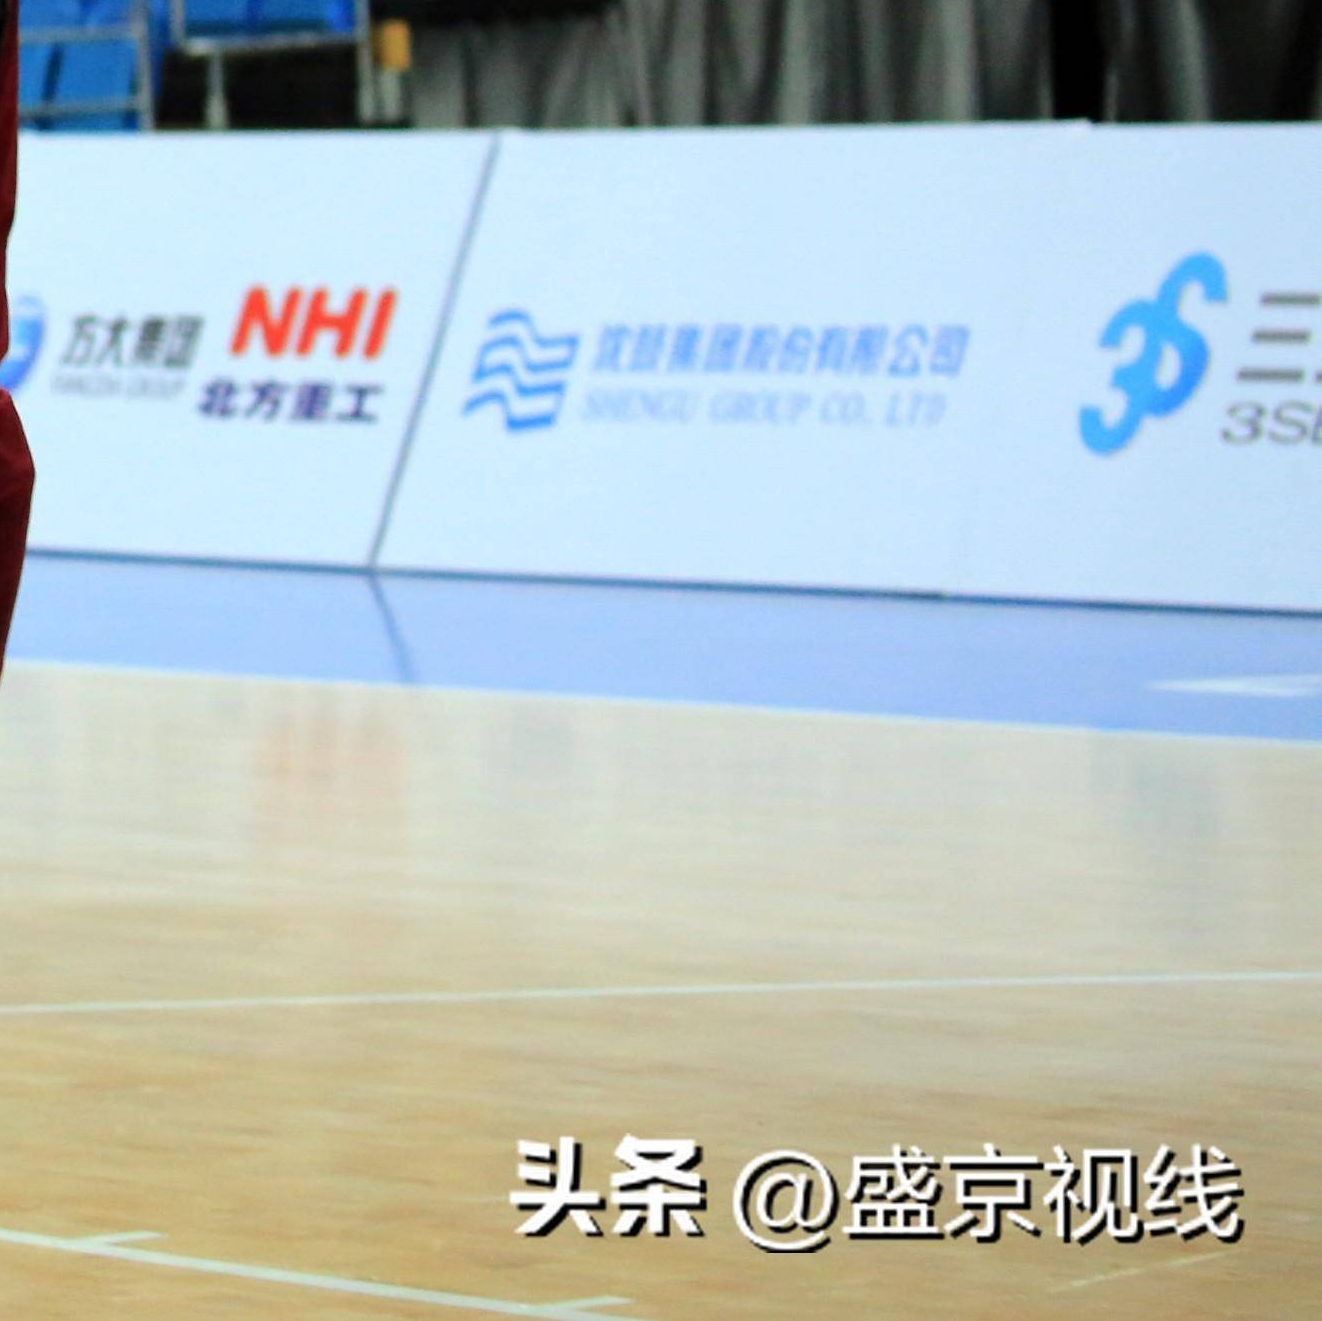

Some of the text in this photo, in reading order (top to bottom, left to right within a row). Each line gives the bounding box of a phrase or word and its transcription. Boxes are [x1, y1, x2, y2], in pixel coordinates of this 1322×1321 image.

[59, 314, 205, 369] 方大集团
[229, 284, 399, 360] NHI
[198, 378, 383, 423] 北方重工
